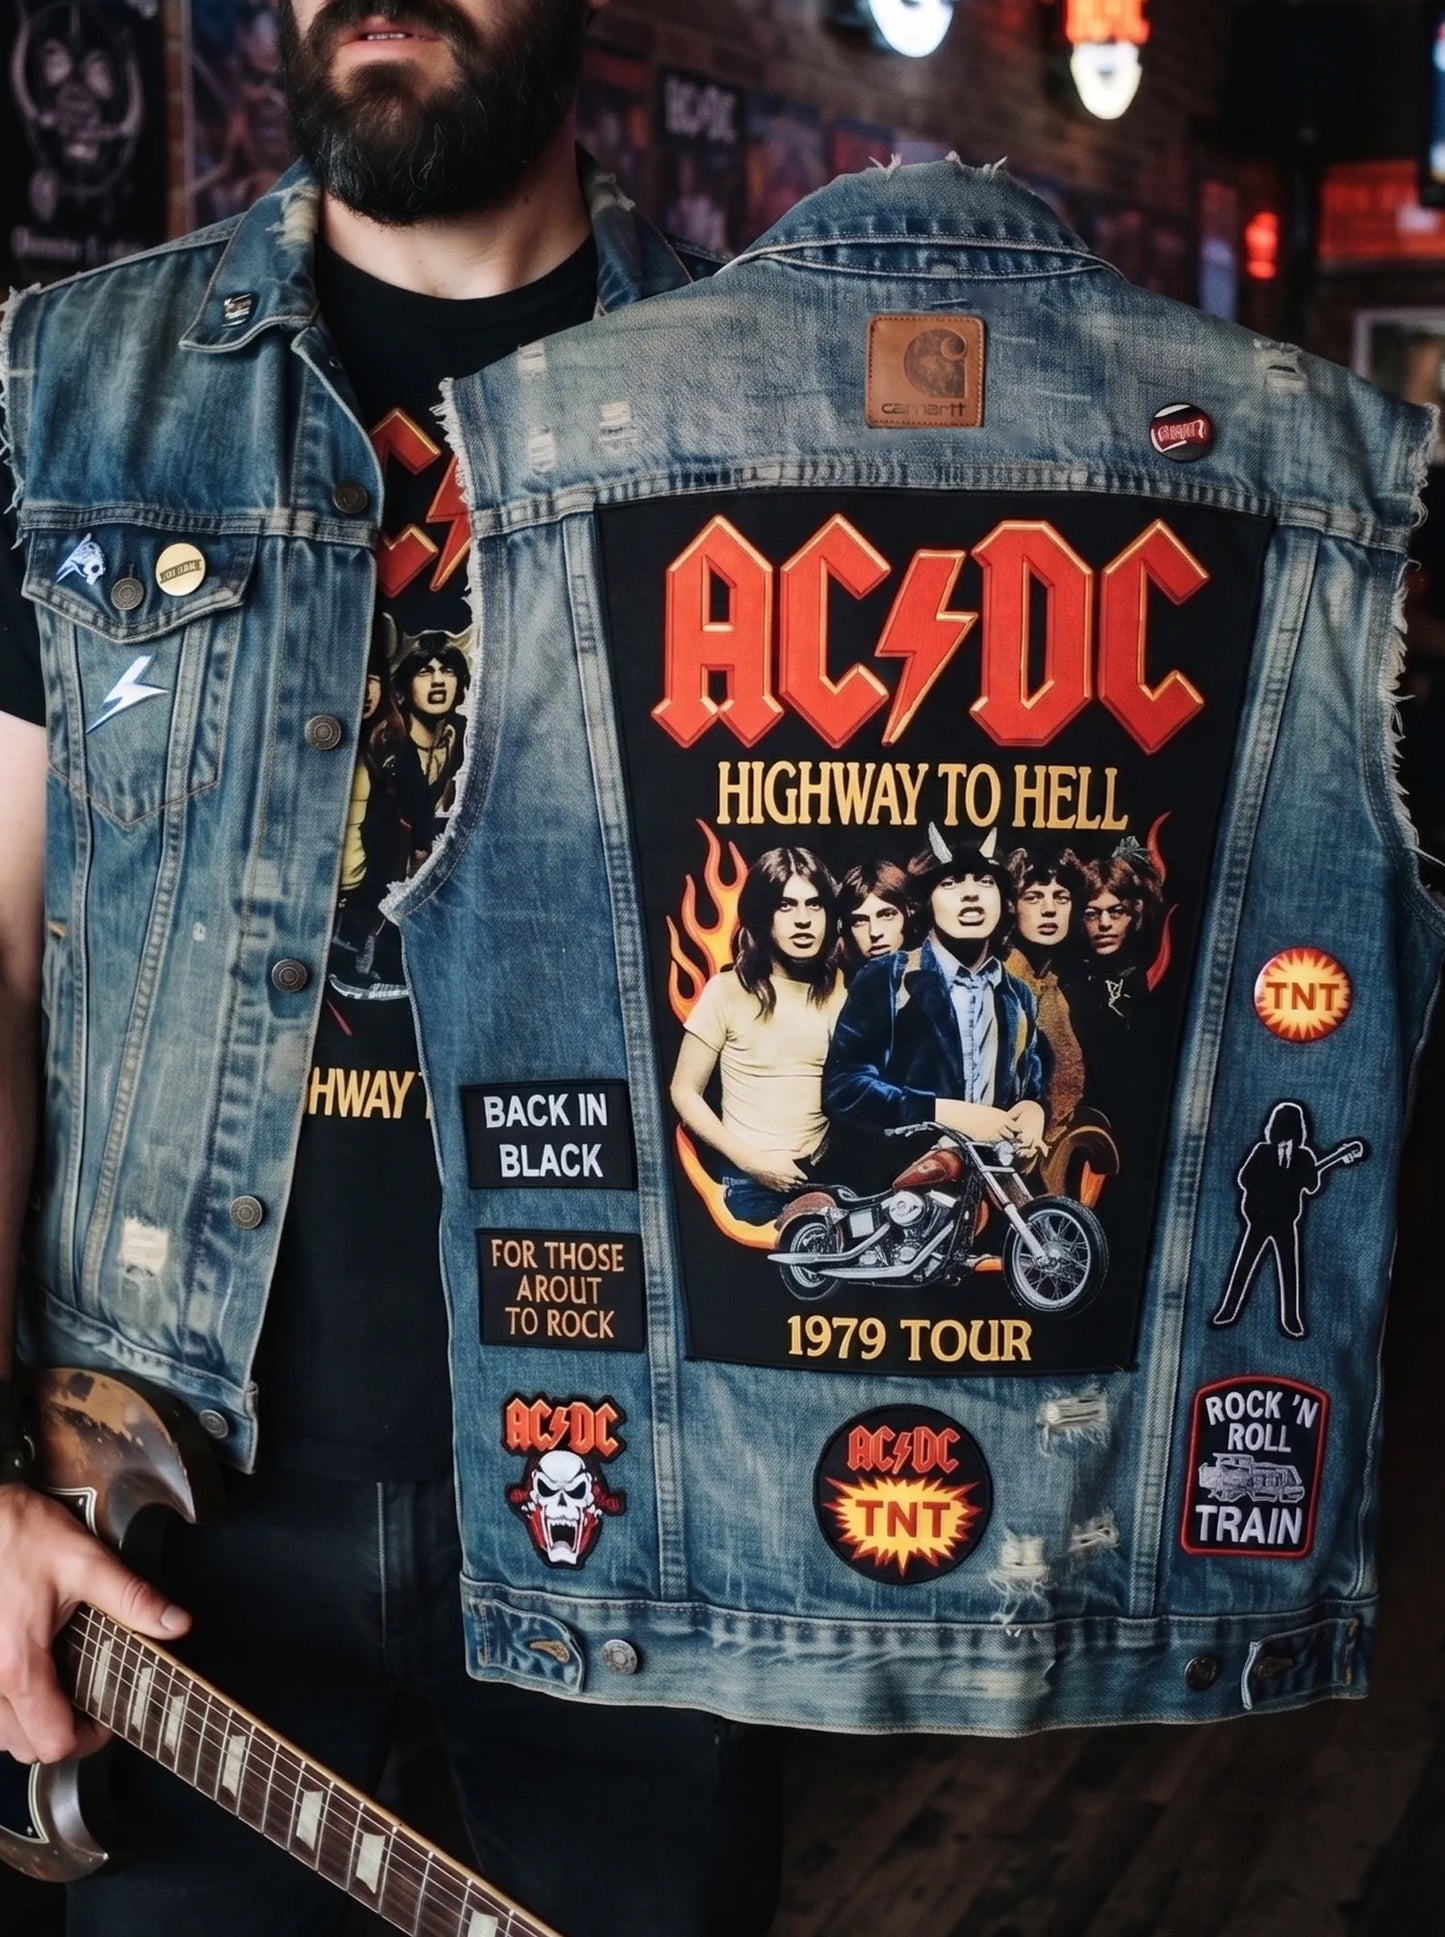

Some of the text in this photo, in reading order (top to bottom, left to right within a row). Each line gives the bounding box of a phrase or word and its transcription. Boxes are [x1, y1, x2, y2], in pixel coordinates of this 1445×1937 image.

[716, 760, 1129, 830] HIGHWAY TO HELL
[1265, 981, 1340, 1012] TNT
[308, 1066, 416, 1120] HWAY
[483, 1093, 608, 1128] BACK IN
[499, 1143, 604, 1178] BLACK
[491, 1239, 625, 1272] FOR THOSE
[505, 1306, 615, 1339] TO ROCK
[787, 1314, 1033, 1362] 1979 TOUR
[1205, 1390, 1283, 1426] ROCK
[1228, 1422, 1292, 1453] ROLL
[855, 1499, 951, 1538] TNT
[1195, 1504, 1303, 1545] TRAIN
